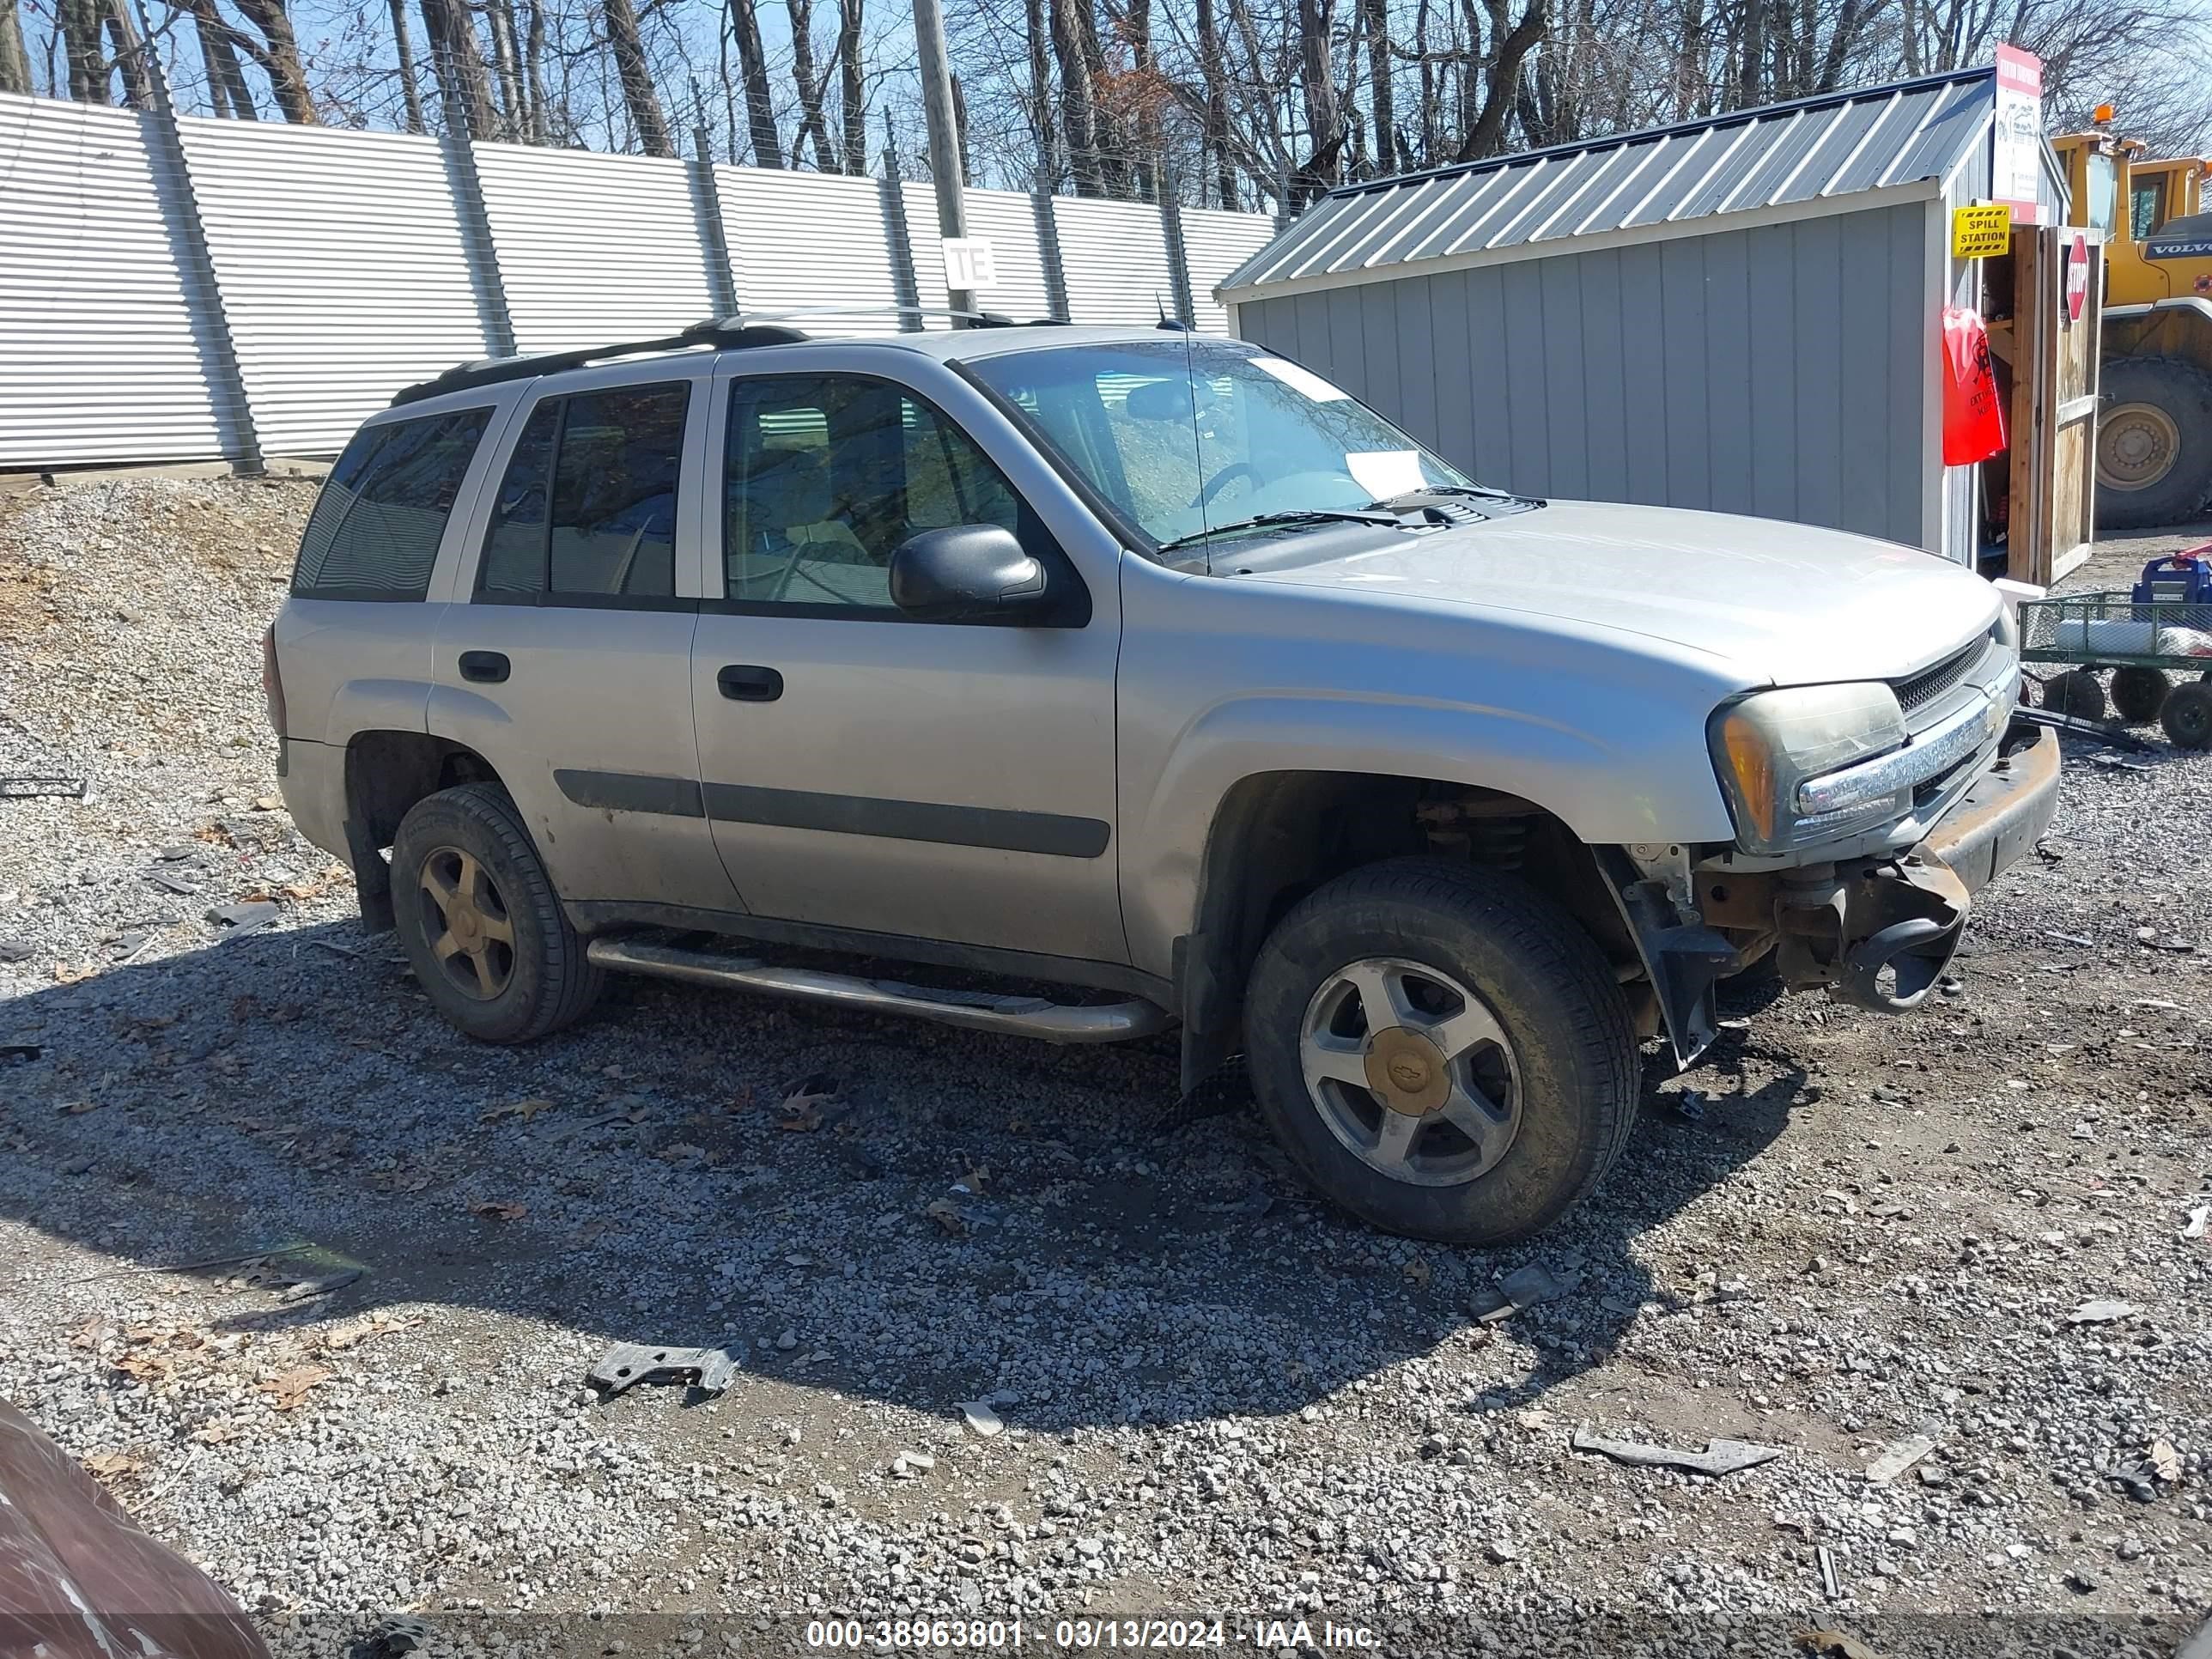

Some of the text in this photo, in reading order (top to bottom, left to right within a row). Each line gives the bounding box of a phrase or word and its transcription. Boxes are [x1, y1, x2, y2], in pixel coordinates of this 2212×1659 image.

[1969, 219, 1999, 229] SPILL
[1960, 232, 2006, 243] STATION
[950, 247, 989, 281] TE
[2068, 262, 2086, 294] STOP
